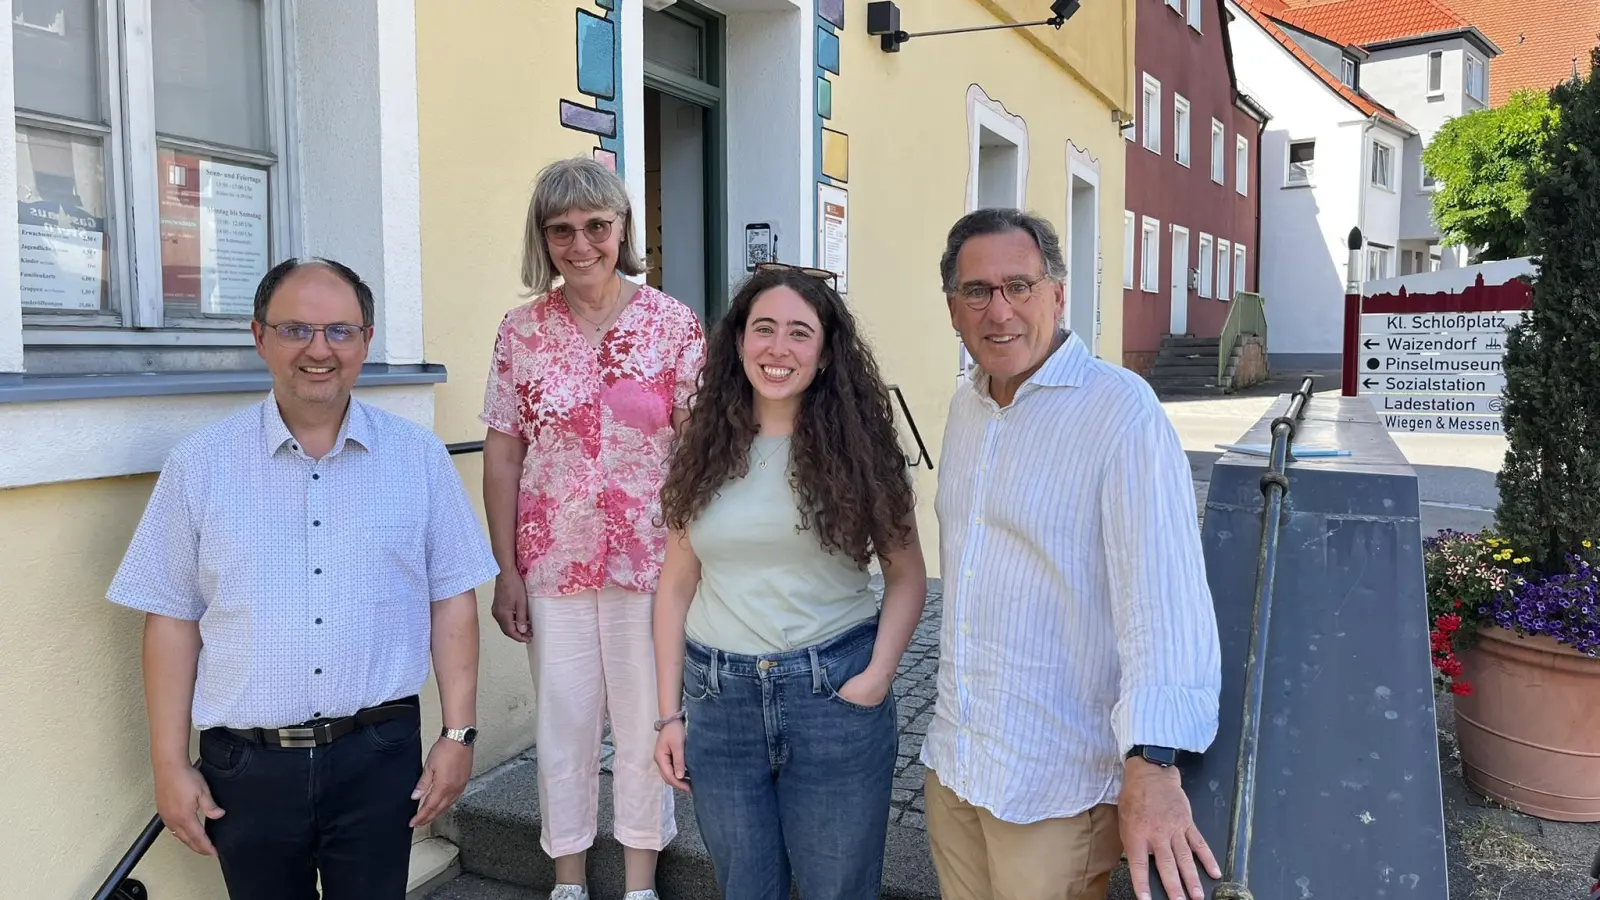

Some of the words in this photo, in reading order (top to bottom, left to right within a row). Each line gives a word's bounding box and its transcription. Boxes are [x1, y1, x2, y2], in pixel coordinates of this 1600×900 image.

[236, 174, 261, 184] Feiertage
[239, 211, 262, 220] Samstag
[21, 229, 52, 238] Erwachsene
[20, 271, 56, 279] Familienkarte
[1387, 316, 1406, 329] Kl.
[1411, 315, 1505, 331] Schloßplatz
[1387, 337, 1477, 351] Waizendorf
[1386, 377, 1486, 391] Sozialstation
[1384, 397, 1475, 411] Ladestation
[1385, 415, 1432, 431] Wiegen
[1436, 416, 1445, 429] &
[1449, 417, 1500, 431] Messen
